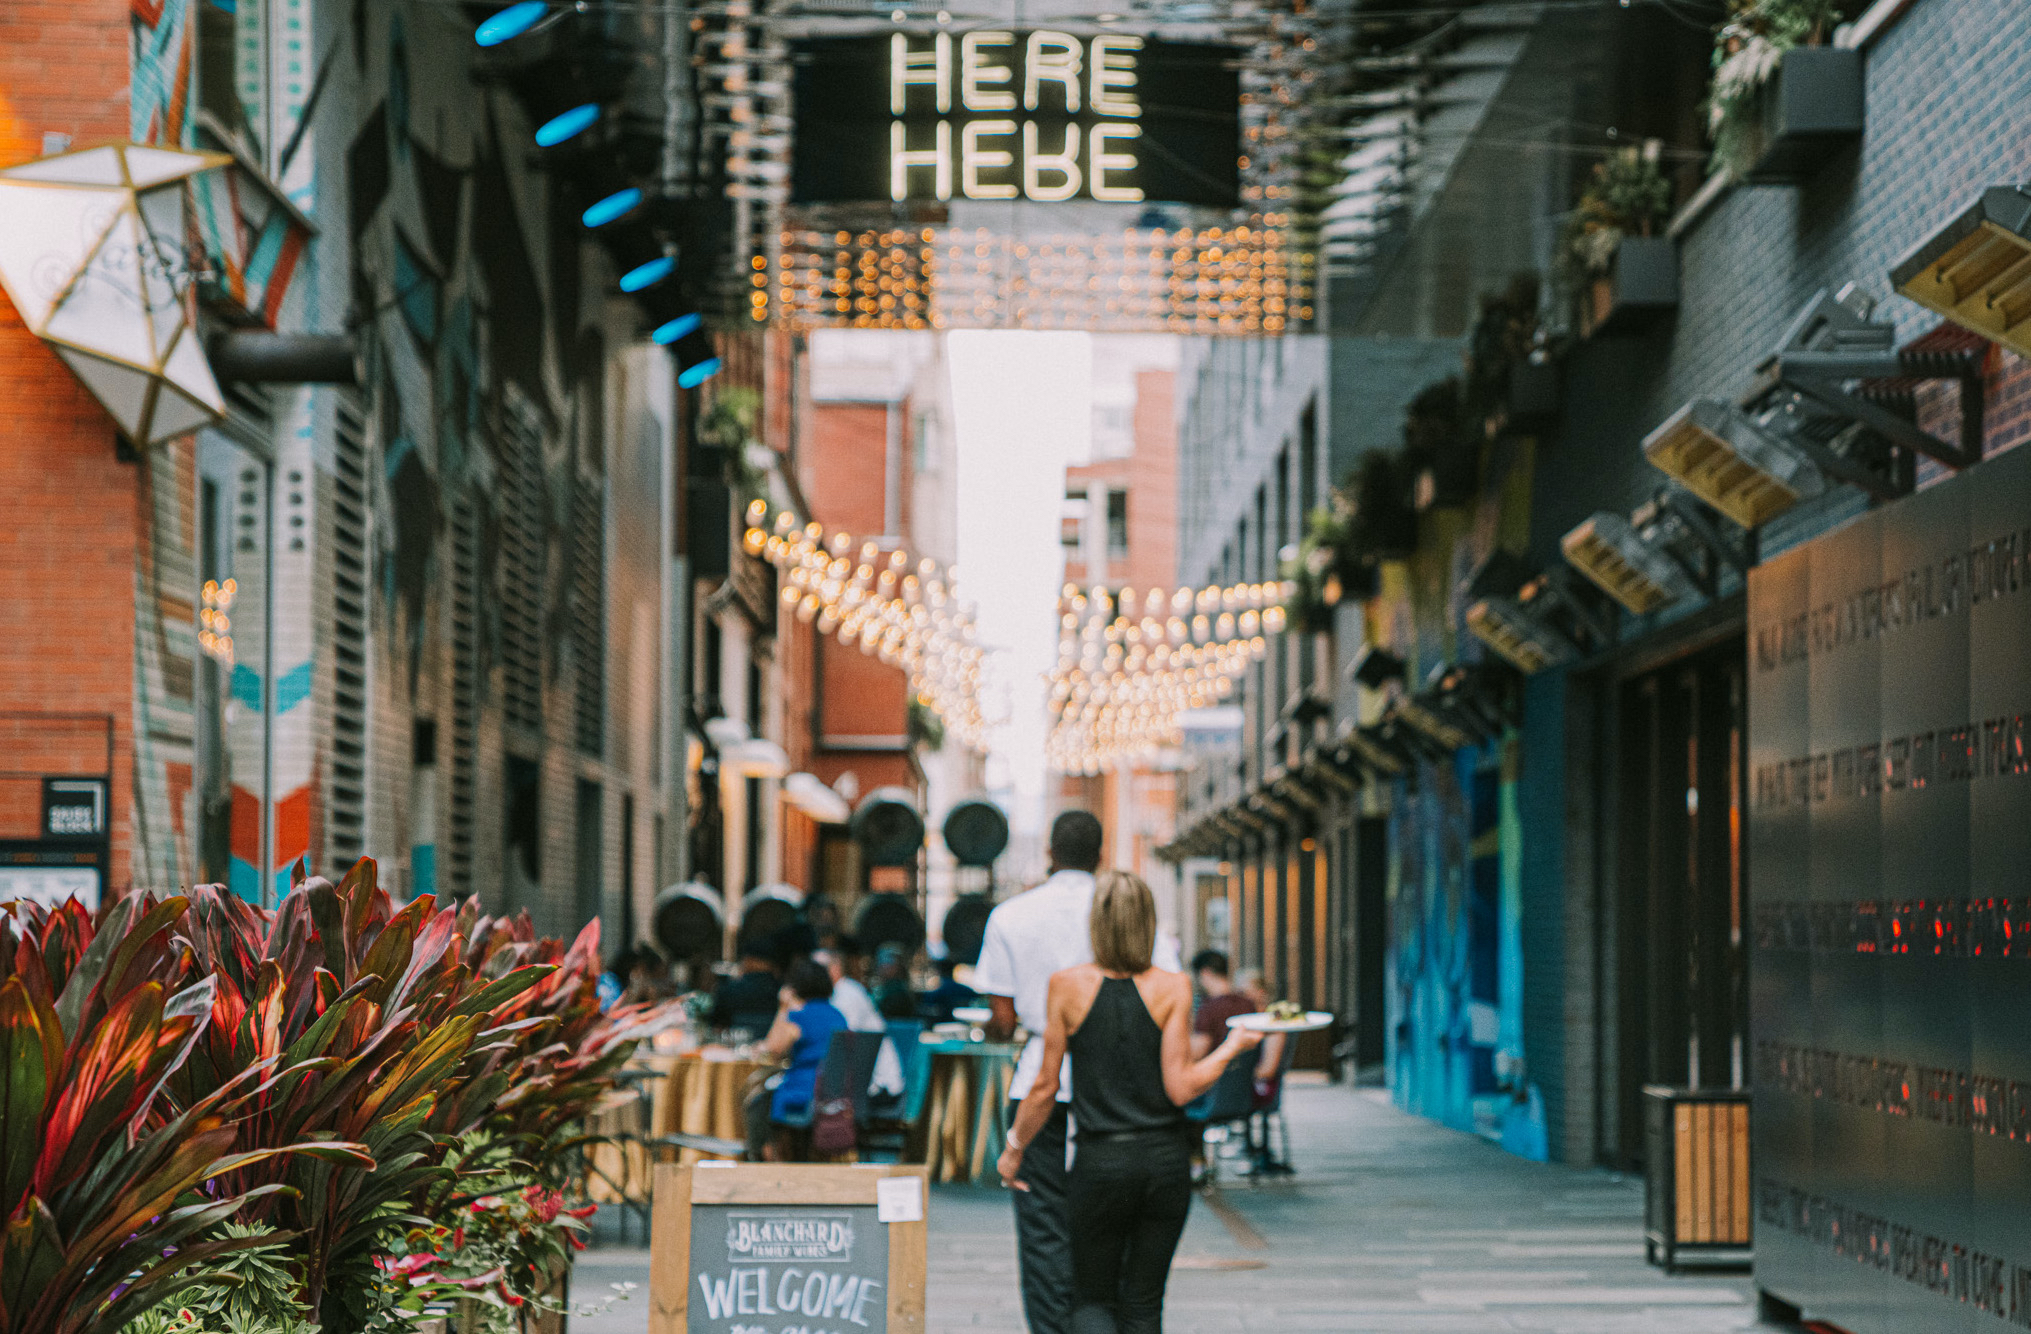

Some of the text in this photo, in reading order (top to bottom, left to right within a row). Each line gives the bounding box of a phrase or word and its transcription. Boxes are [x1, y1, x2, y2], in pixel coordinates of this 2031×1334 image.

[891, 31, 1144, 117] HERE
[735, 1220, 845, 1252] BLANCHARD
[752, 1245, 790, 1257] FAMILY
[698, 1267, 882, 1327] WELCOME
